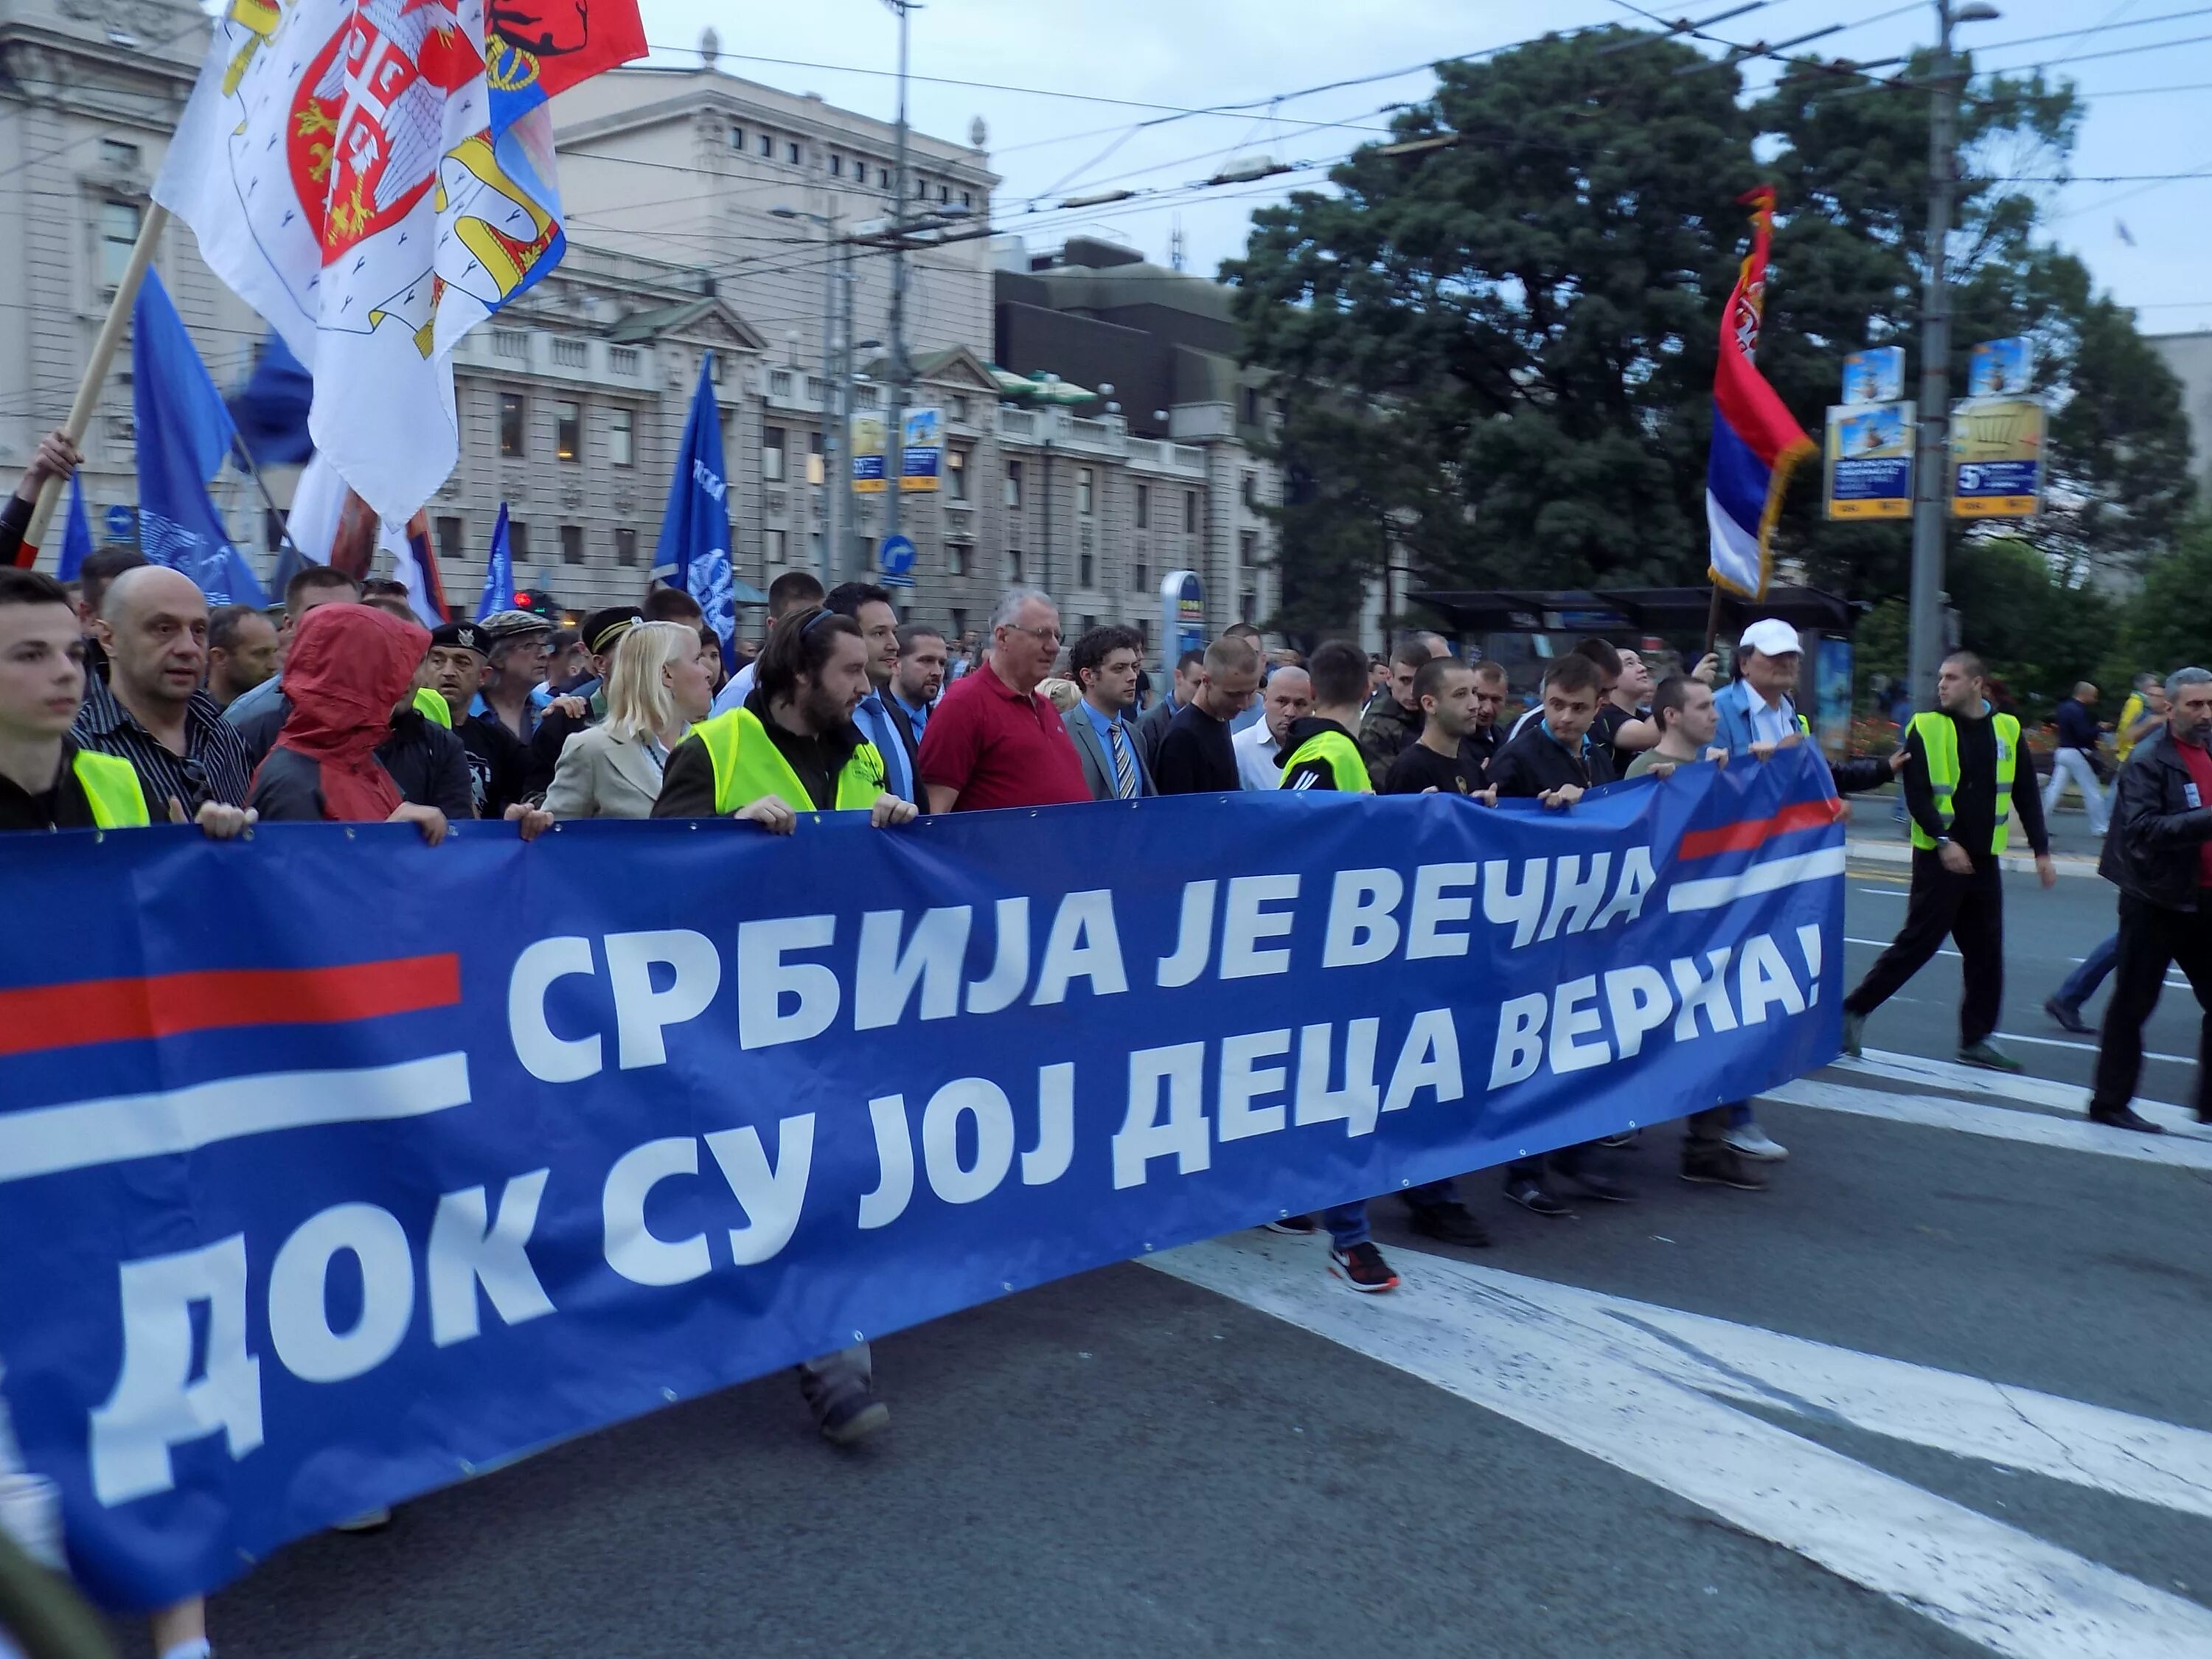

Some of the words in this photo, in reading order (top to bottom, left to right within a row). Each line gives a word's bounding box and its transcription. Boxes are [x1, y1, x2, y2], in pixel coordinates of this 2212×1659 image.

[509, 889, 1128, 1083] СРБИЈА
[1157, 874, 1301, 987] ЈЕ
[1323, 846, 1656, 968] ВЕЧНА
[91, 1169, 557, 1503] ДОК
[602, 1113, 815, 1286] СУ
[858, 1062, 1074, 1228] ЈОЈ
[1113, 1007, 1464, 1190] ДЕЦА
[1487, 923, 1823, 1091] ВЕРНА!
